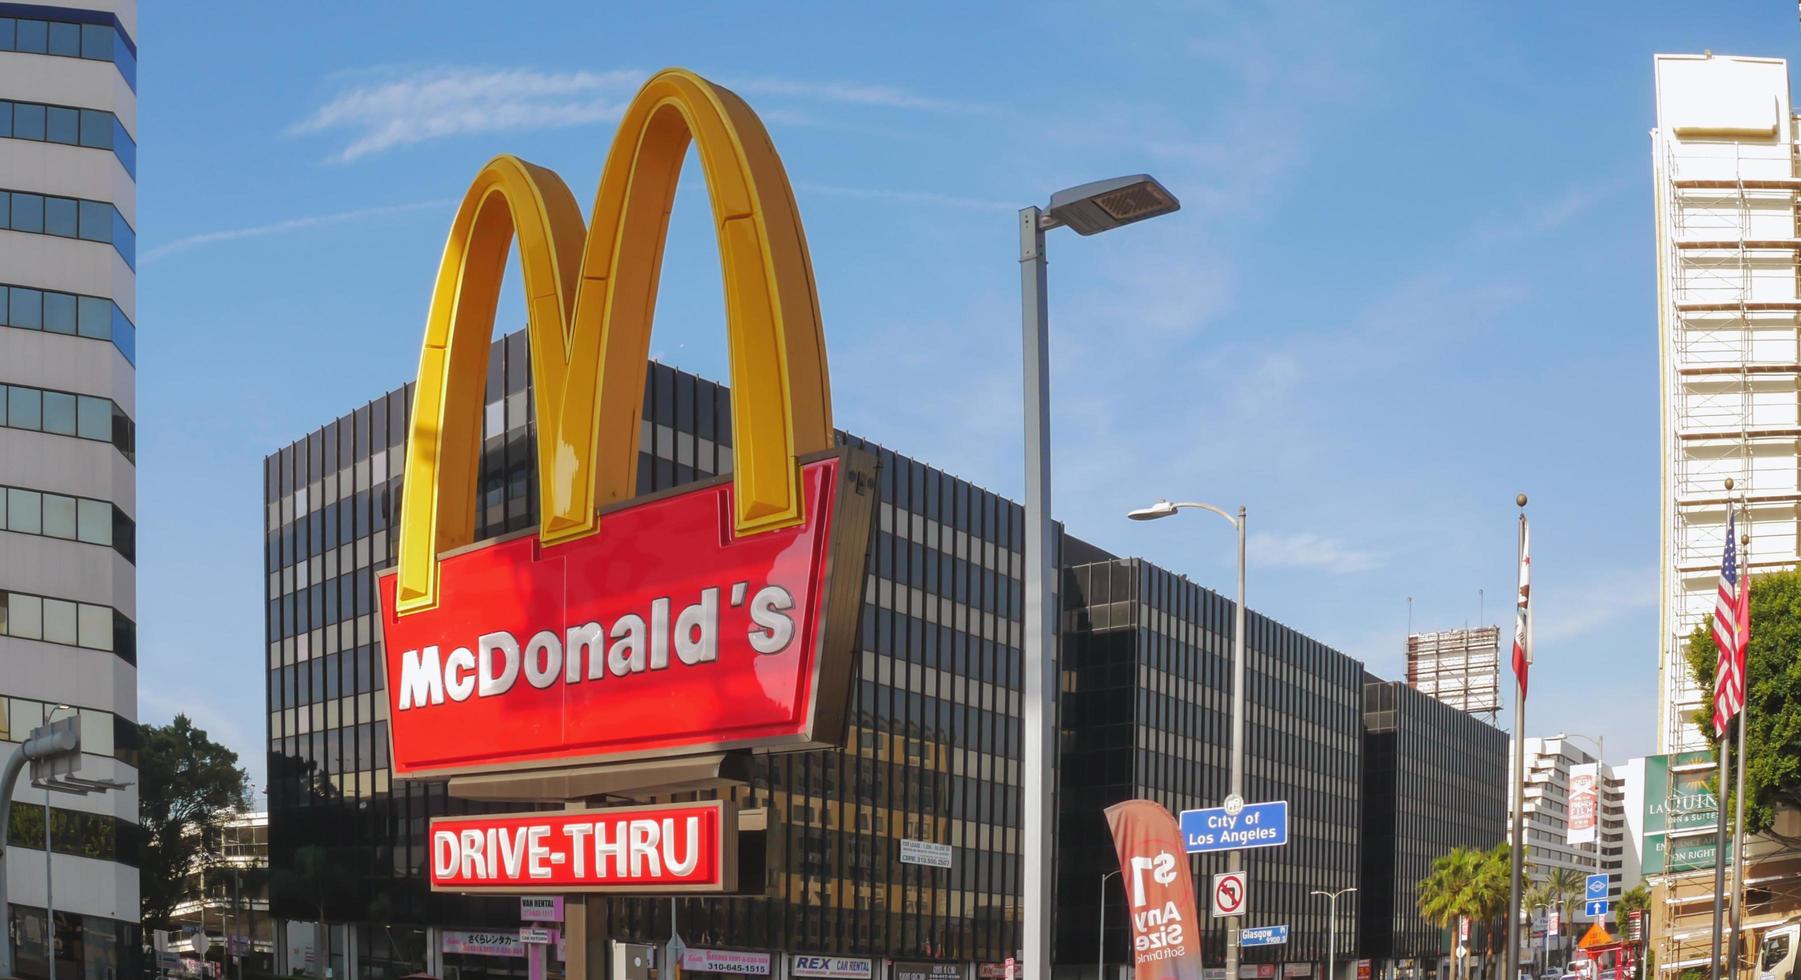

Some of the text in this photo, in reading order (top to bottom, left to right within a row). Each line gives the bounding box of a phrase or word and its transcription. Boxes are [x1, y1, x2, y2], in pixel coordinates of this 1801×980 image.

[399, 581, 796, 711] McDonald's
[1650, 793, 1718, 816] LA QUIN
[1208, 811, 1260, 829] City of
[1189, 828, 1276, 845] Los Angeles
[434, 816, 698, 880] DRIVE-THRU
[1688, 848, 1716, 860] RIGHT
[468, 934, 518, 945] さくらレンタカー
[1242, 929, 1272, 941] Glasgow
[707, 962, 766, 974] 310-645-1515
[797, 957, 869, 972] REX CAR RENTAL
